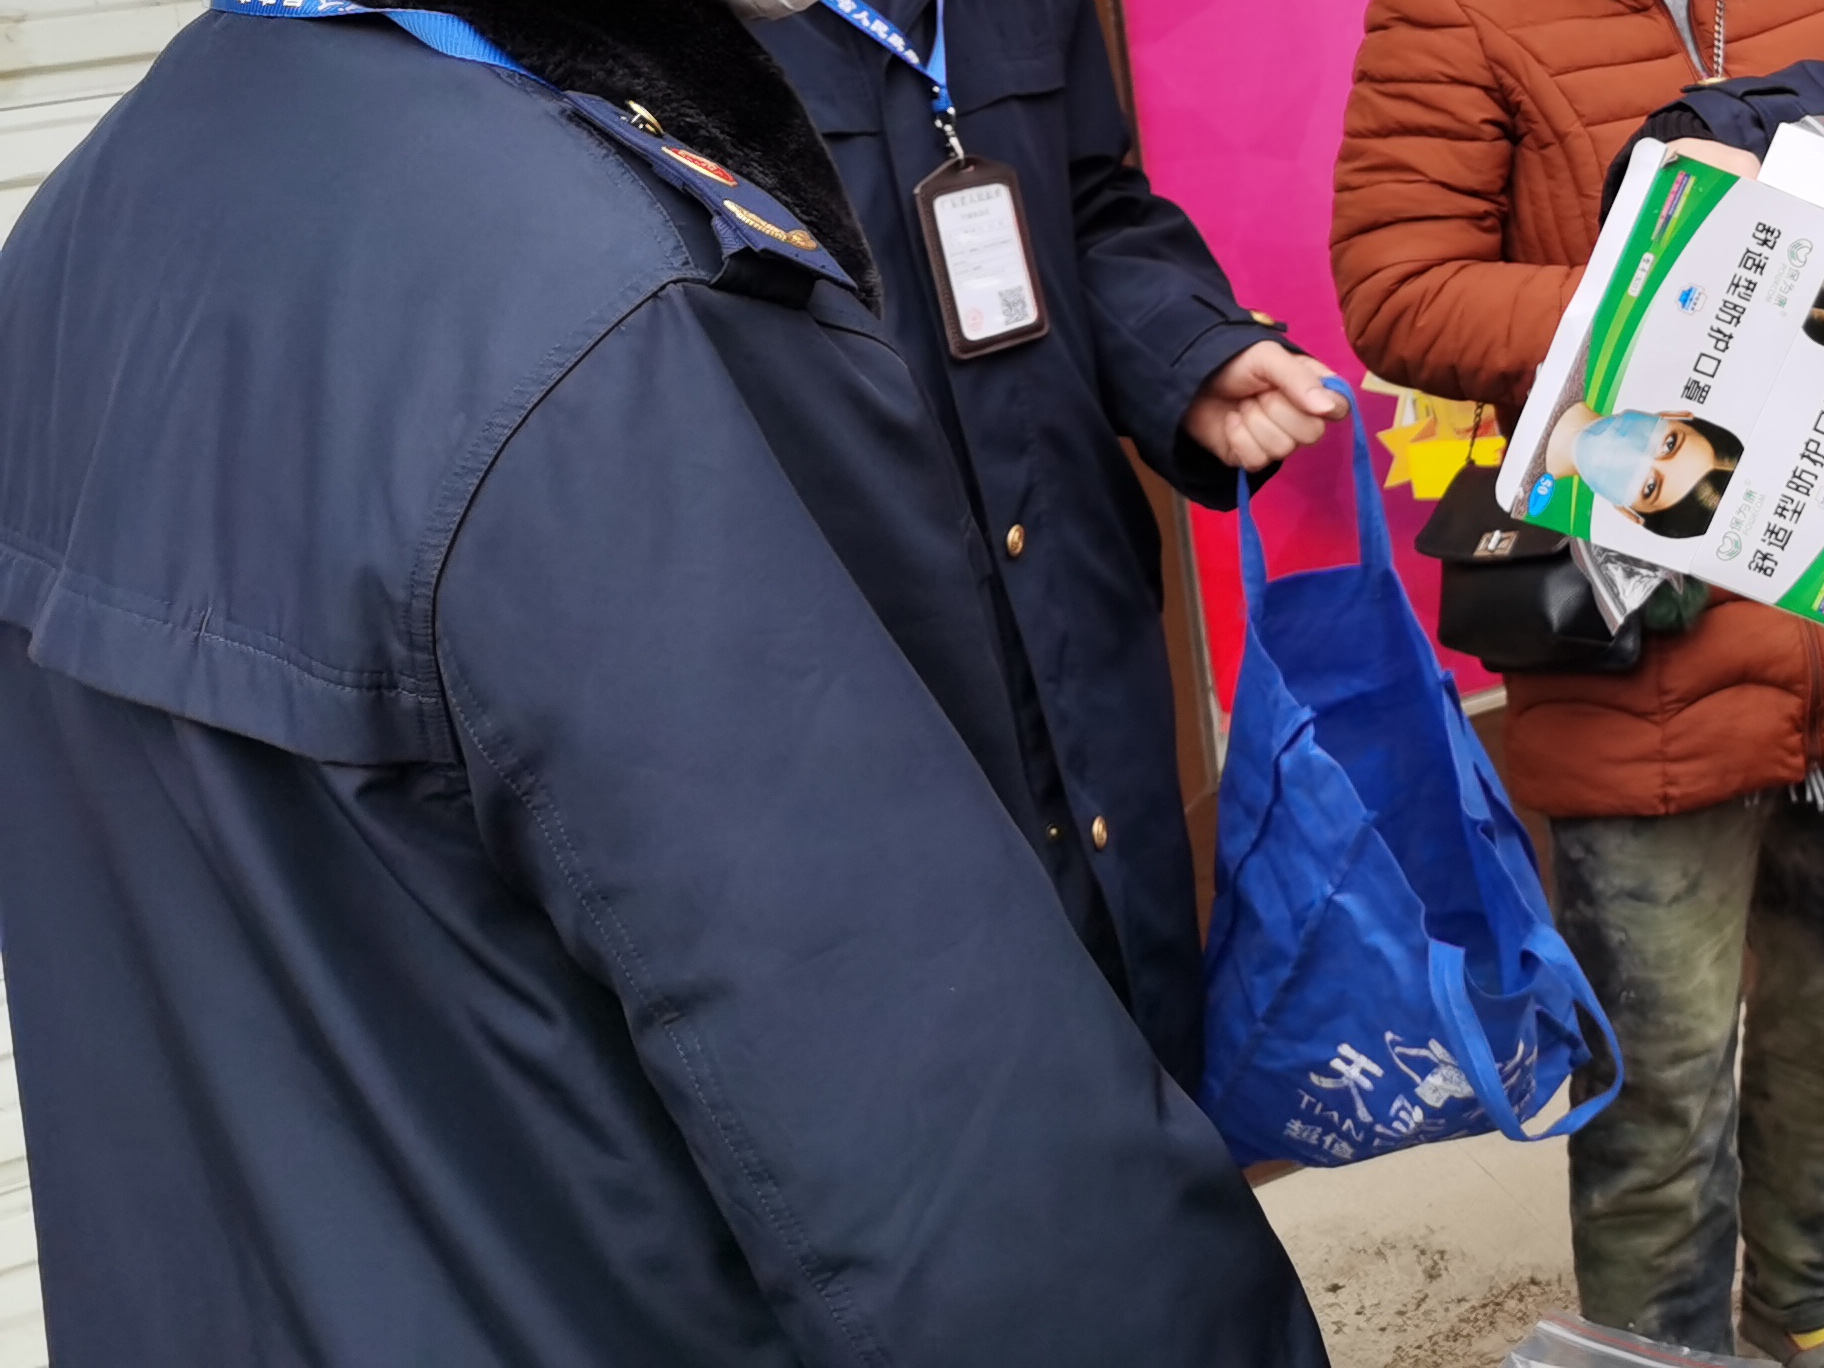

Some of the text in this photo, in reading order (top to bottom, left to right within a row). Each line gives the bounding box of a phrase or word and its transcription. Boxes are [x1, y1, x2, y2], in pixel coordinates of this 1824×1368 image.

[1773, 267, 1801, 309] 保为康
[1681, 222, 1781, 404] 舒适型防护口罩
[1729, 487, 1758, 532] 保为康
